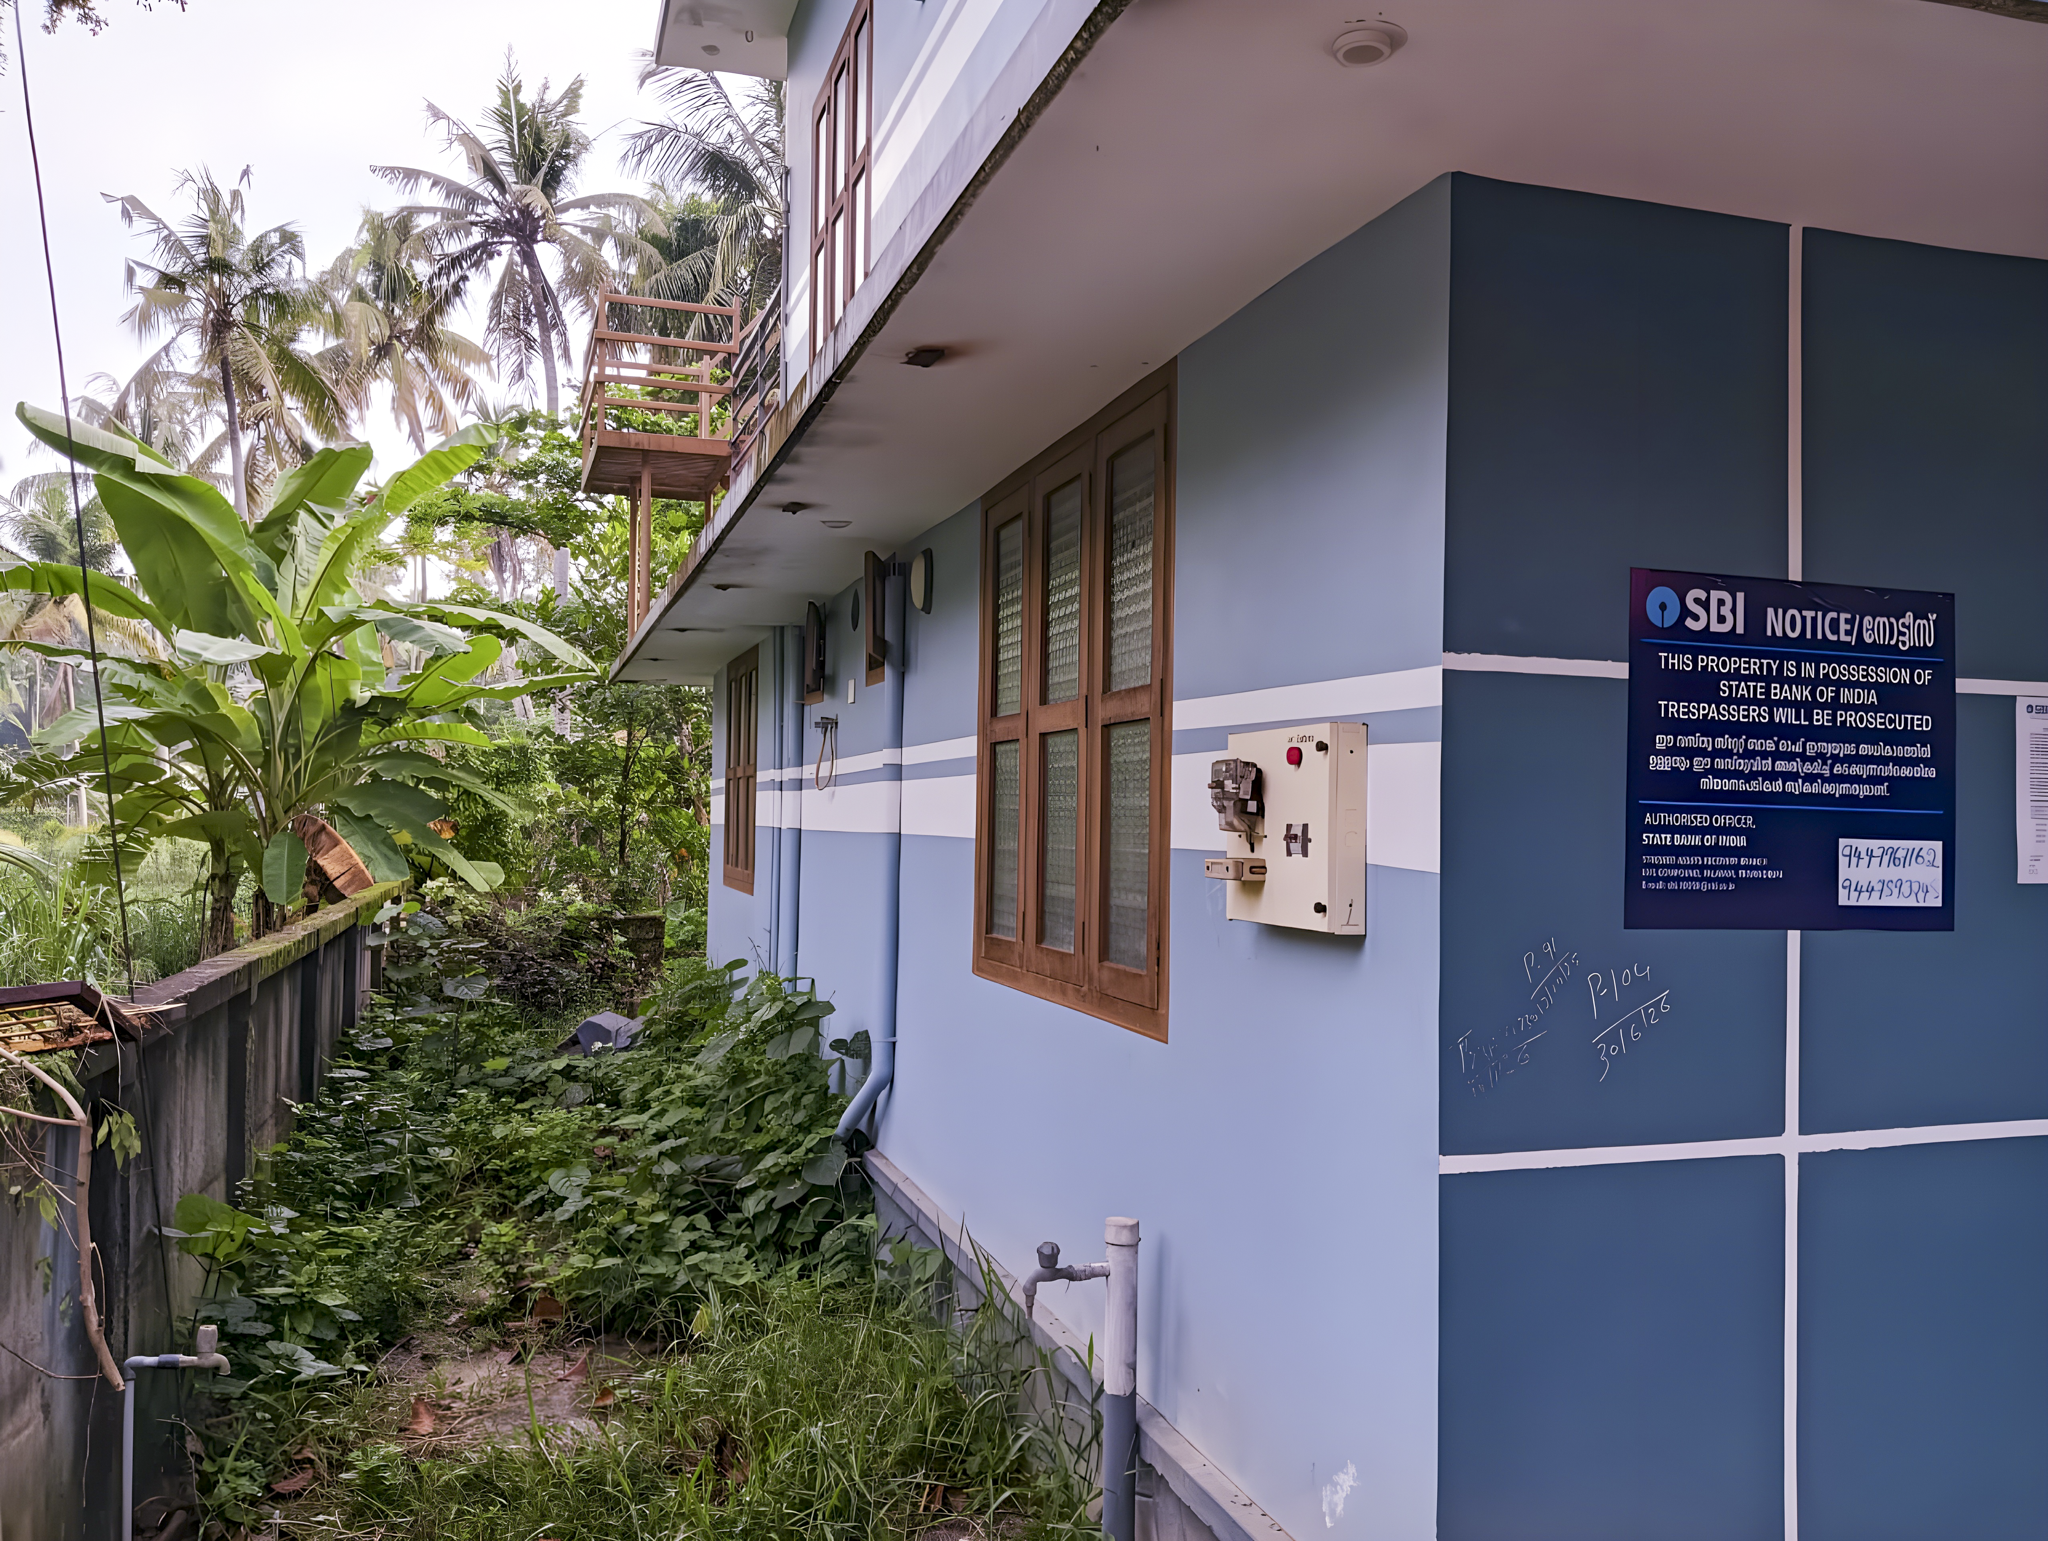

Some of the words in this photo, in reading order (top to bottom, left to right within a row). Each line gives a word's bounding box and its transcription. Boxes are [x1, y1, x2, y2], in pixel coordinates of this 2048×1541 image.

[1685, 588, 1745, 634] SBI
[1658, 652, 1693, 672] THIS
[1698, 655, 1780, 677] PROPERTY
[1783, 660, 1797, 677] IS
[1801, 661, 1816, 679] IN
[1820, 662, 1910, 685] POSSESSION
[1914, 668, 1933, 686] OF
[1719, 681, 1766, 699] STATE
[1771, 683, 1812, 702] BANK
[1816, 686, 1836, 703] OF
[1840, 687, 1878, 706] INDIA
[1658, 700, 1769, 723] TRESPASSERS
[1773, 706, 1809, 726] WILL
[1813, 709, 1833, 727] BE
[1837, 710, 1933, 731] PROSECUTED
[1644, 813, 1710, 827] AUTHORISED
[1642, 833, 1672, 845] STATE
